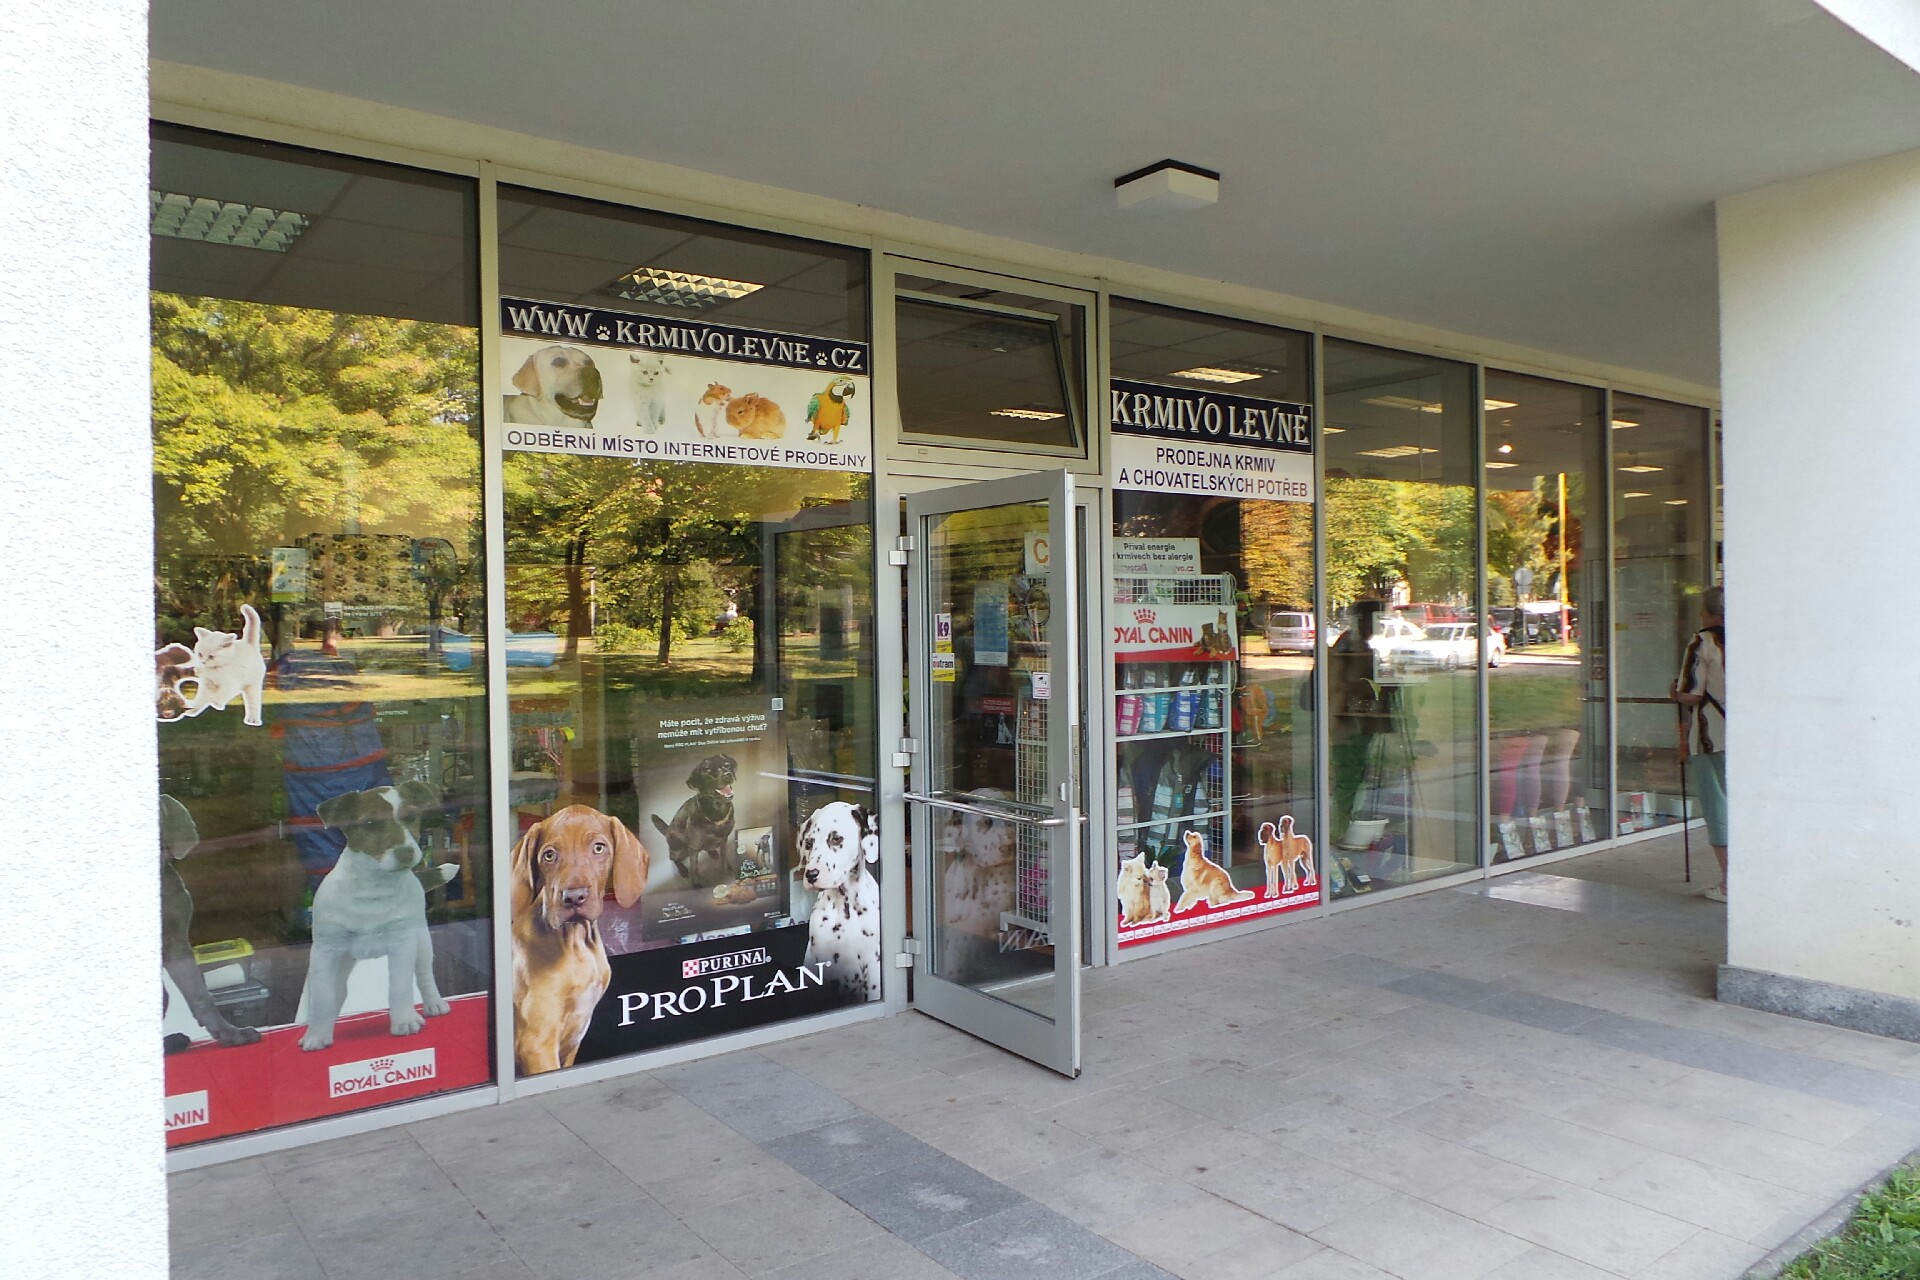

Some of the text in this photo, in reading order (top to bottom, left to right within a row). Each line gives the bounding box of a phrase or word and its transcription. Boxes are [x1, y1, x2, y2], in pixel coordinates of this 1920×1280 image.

[508, 304, 864, 370] WWW KRMIVOLEVNE CZ
[1111, 389, 1310, 446] KRMIVO LEVNĚ
[507, 428, 867, 469] ODBĚRNÍ MÍSTO INTERNETOVÉ PRODEJNY
[1156, 447, 1275, 473] PRODEJNA KRMIV
[1119, 468, 1308, 498] A CHOVATELSKÝCH POTŘEB
[1116, 552, 1194, 561] krmivech bez alergie
[1147, 542, 1176, 553] energie
[1148, 626, 1193, 643] CANIN
[660, 719, 679, 728] Máte
[704, 716, 713, 724] že
[715, 714, 740, 723] zdravá
[742, 713, 765, 723] výživa
[658, 729, 689, 739] nemůže
[699, 951, 763, 973] PURINA
[334, 1063, 433, 1095] ROYAL CANIN
[164, 1108, 205, 1128] ANIN
